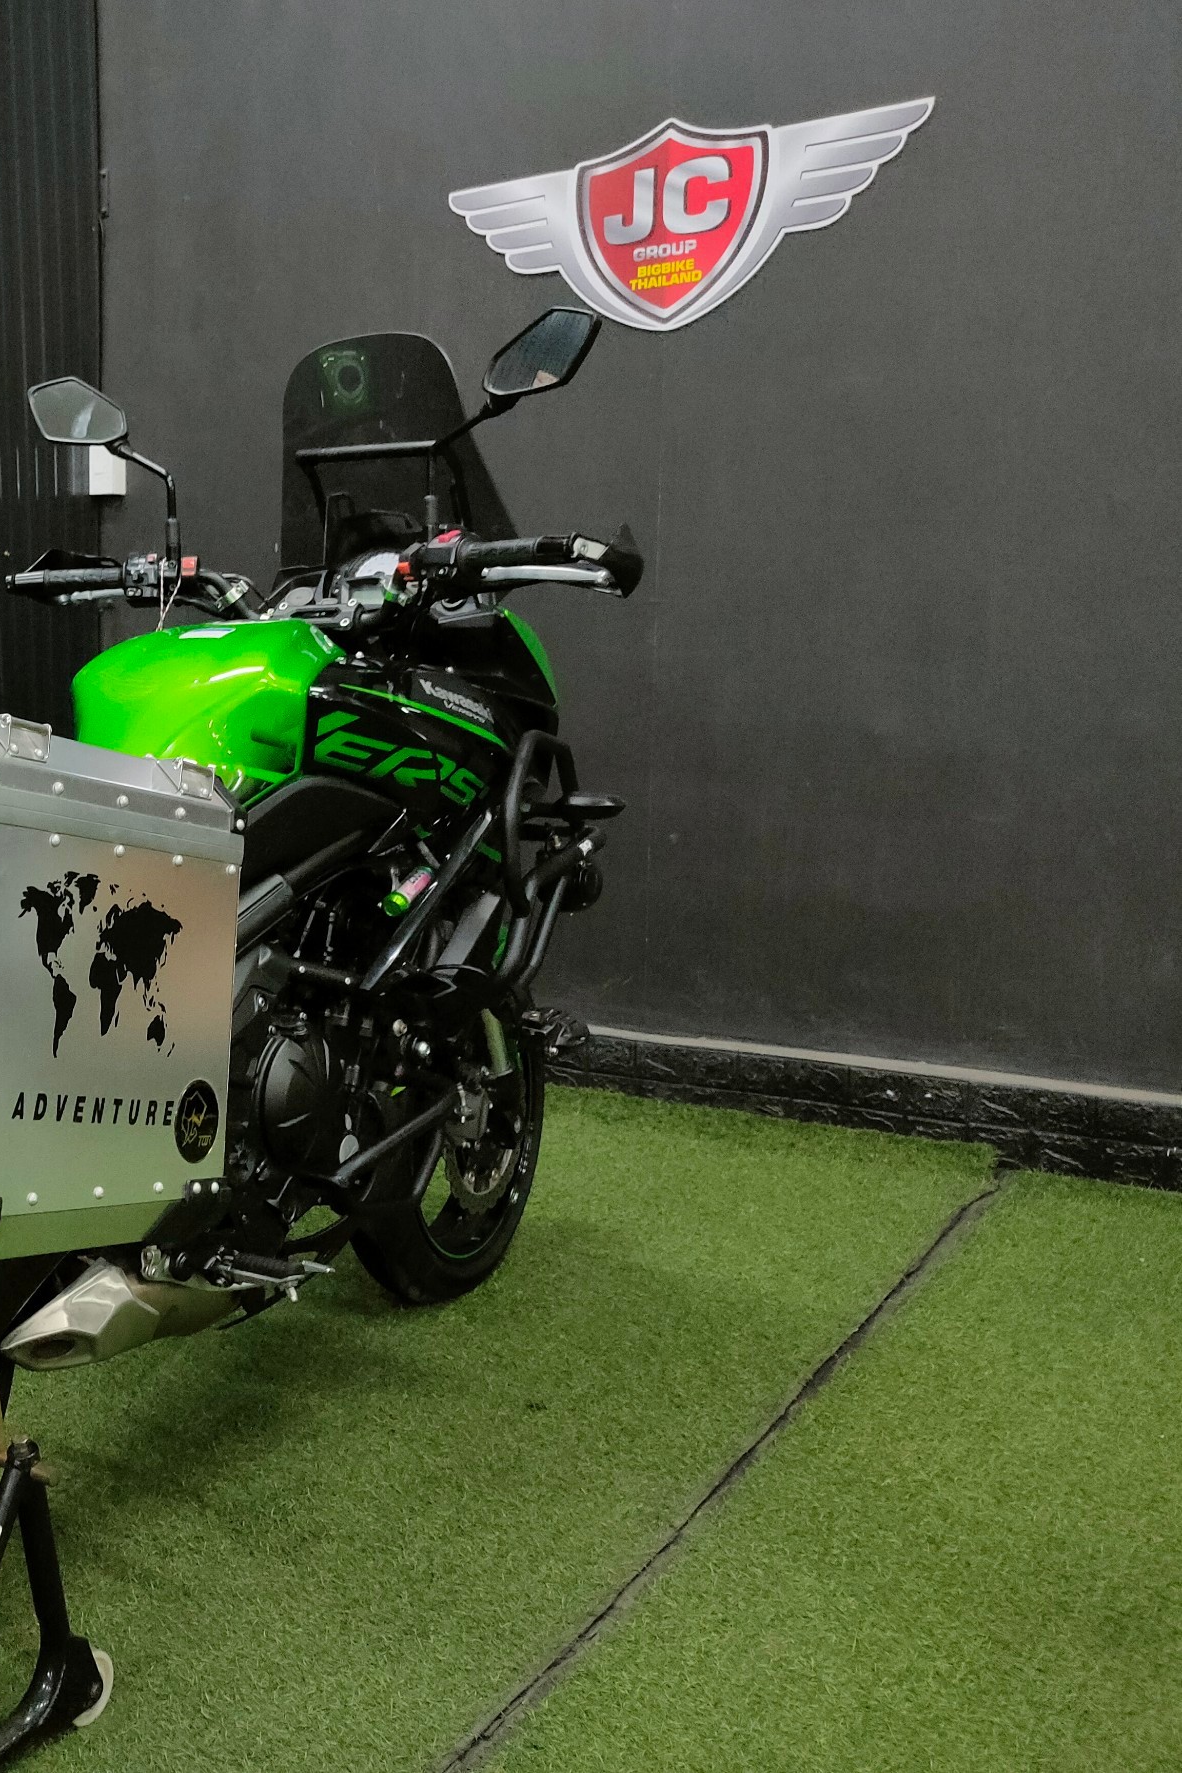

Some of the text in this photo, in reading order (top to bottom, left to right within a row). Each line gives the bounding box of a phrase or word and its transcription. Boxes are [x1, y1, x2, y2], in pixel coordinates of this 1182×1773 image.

[603, 154, 732, 246] JC
[633, 239, 698, 262] GROUP
[637, 258, 695, 278] BIGBIKE
[629, 270, 703, 292] THAILAND
[11, 1091, 175, 1126] ADVENTURE
